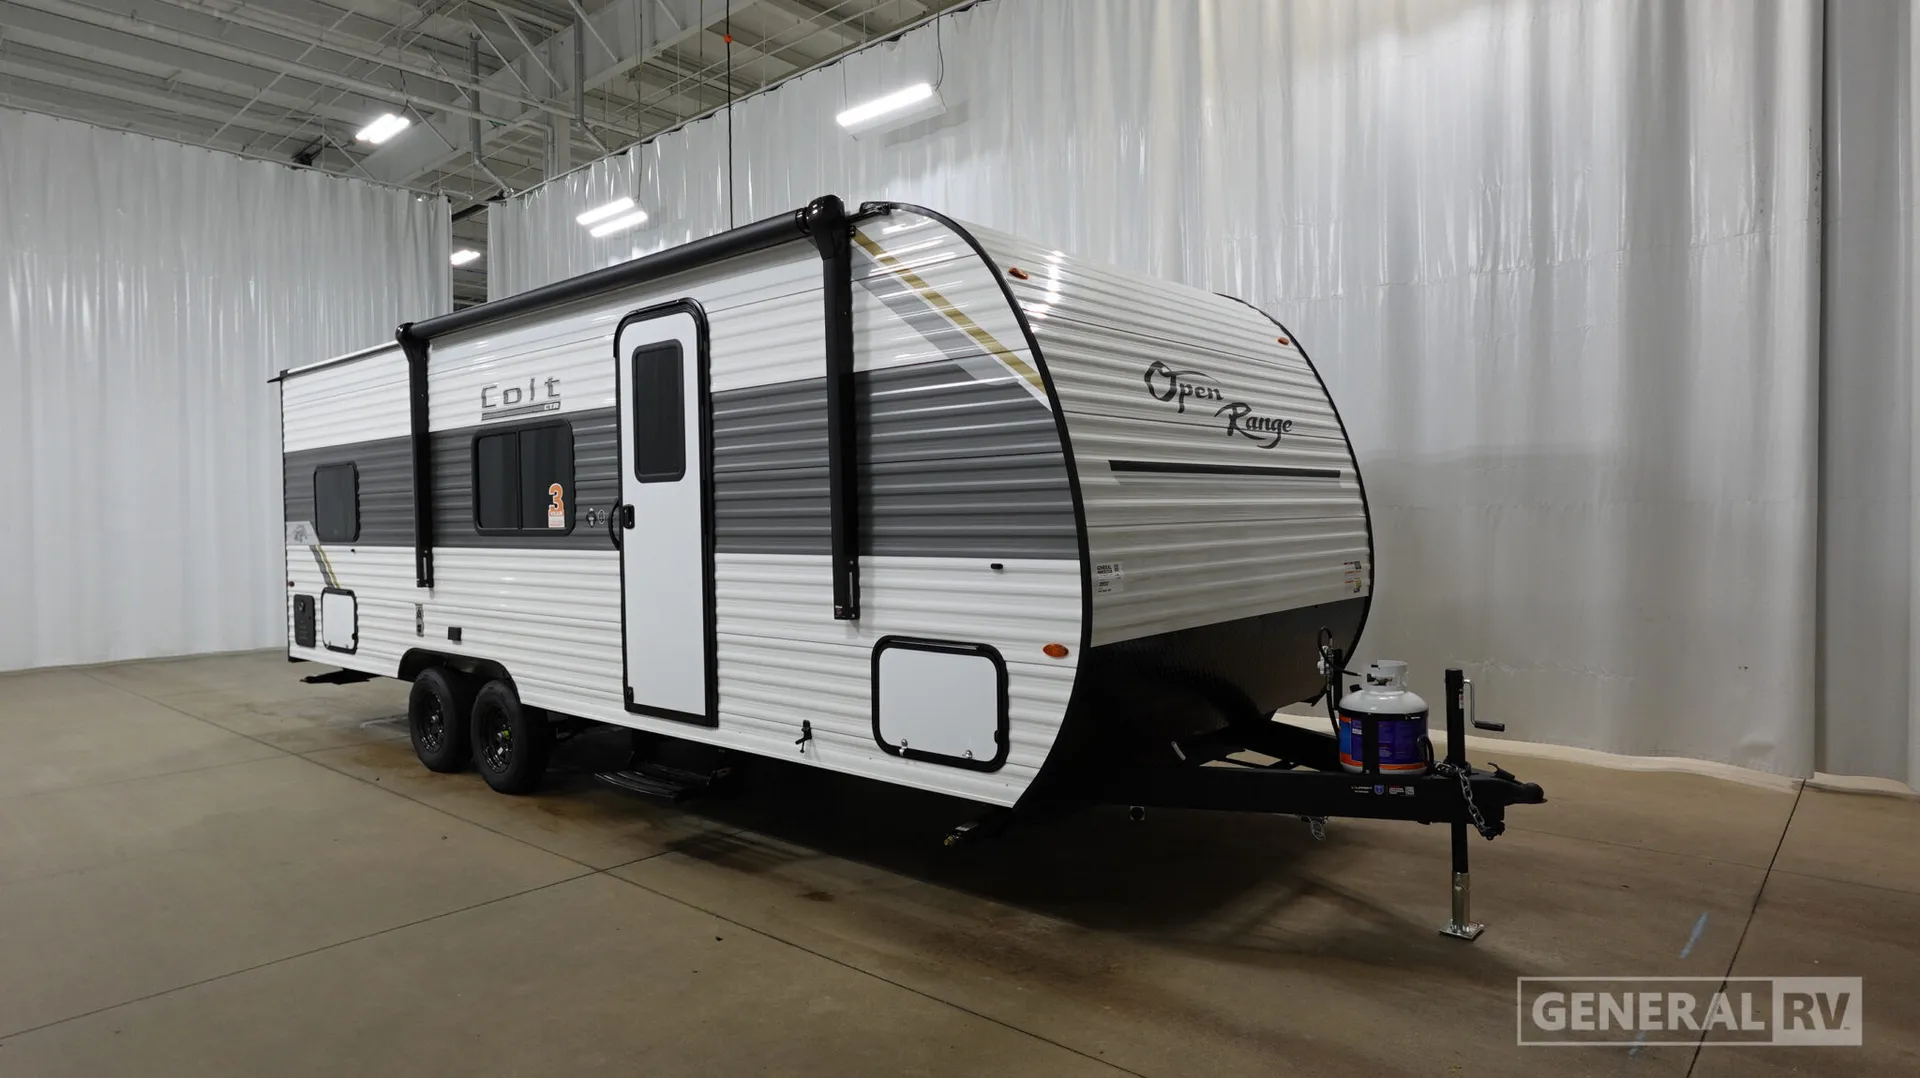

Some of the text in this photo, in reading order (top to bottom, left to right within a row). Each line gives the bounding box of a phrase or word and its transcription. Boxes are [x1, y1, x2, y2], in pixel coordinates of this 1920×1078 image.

[481, 377, 560, 408] Colt
[1144, 361, 1224, 413] Open
[1214, 402, 1293, 449] Range
[549, 483, 564, 512] 3
